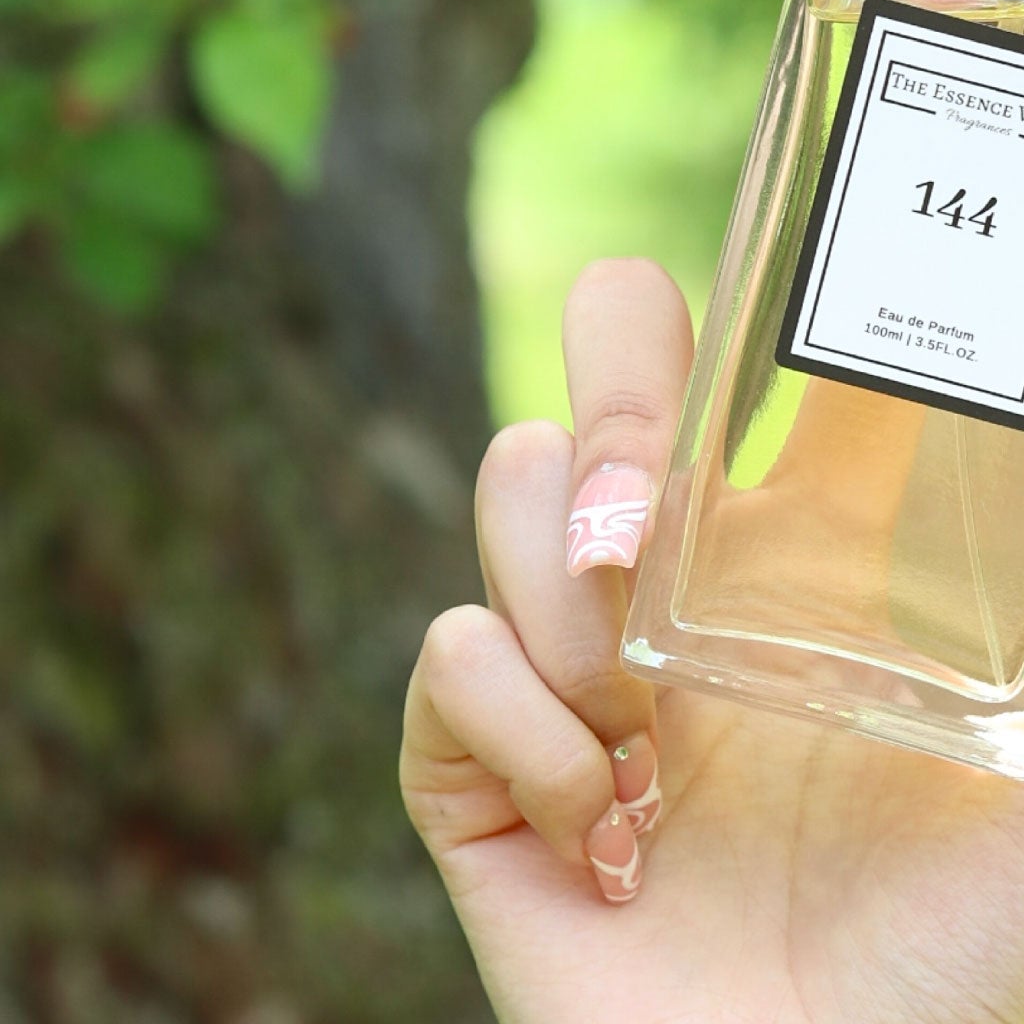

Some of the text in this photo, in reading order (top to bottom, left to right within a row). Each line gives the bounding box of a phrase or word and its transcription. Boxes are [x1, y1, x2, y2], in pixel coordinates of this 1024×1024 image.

[891, 71, 928, 96] THE
[932, 82, 1014, 119] ESSENCE
[945, 108, 1013, 136] Fragrances
[911, 181, 998, 238] 144
[864, 323, 904, 341] 100ml
[878, 307, 975, 342] Eau de Parfum
